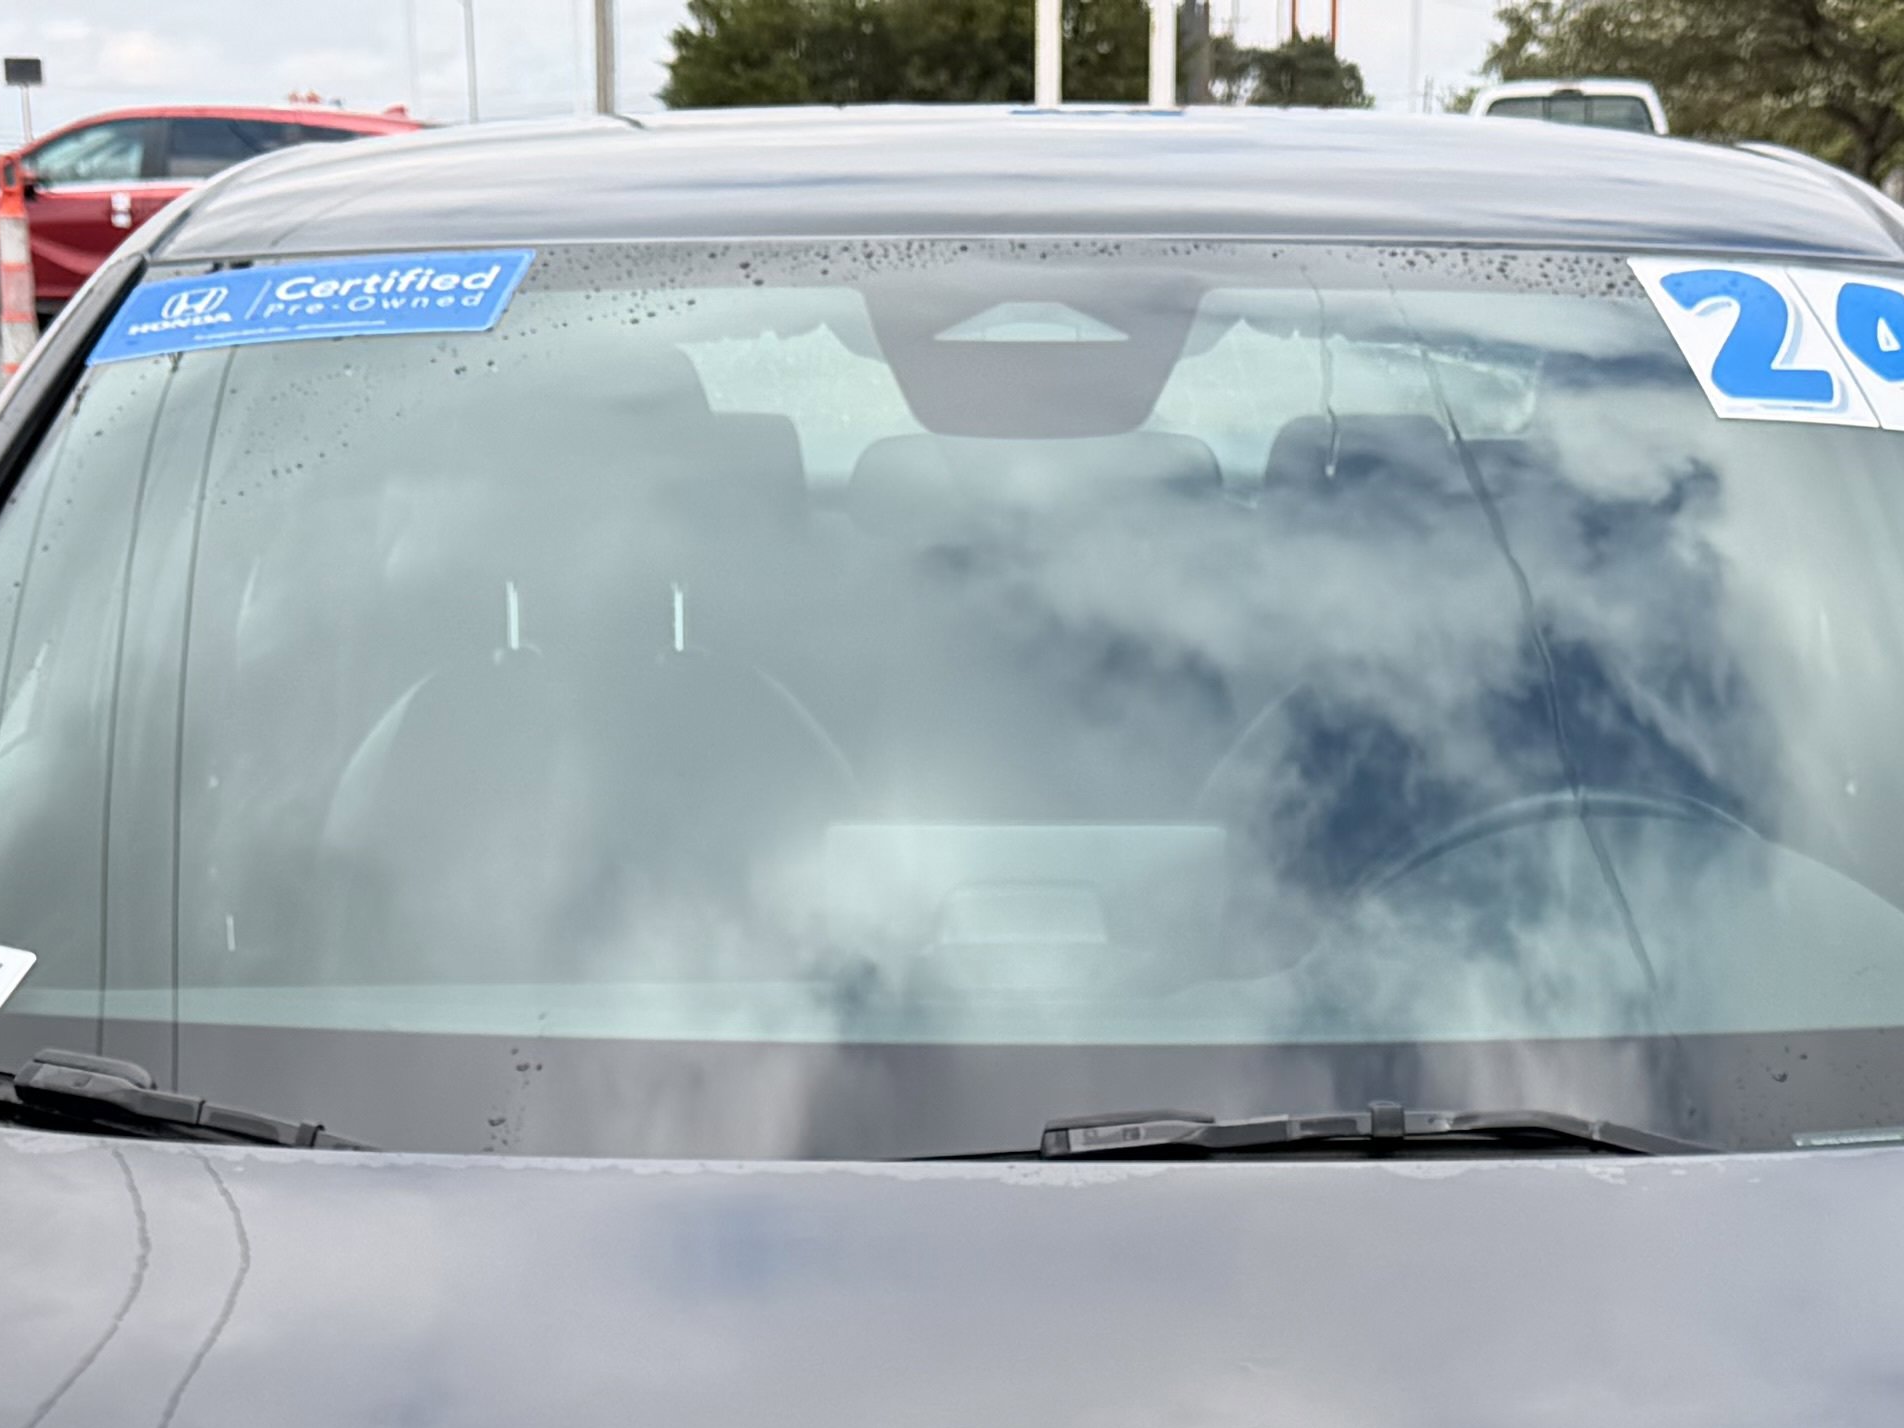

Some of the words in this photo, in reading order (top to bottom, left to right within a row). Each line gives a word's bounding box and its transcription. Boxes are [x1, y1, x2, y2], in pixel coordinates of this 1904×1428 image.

[275, 265, 501, 301] Certified
[263, 291, 485, 319] Pre-Owned
[128, 311, 233, 336] HONDA
